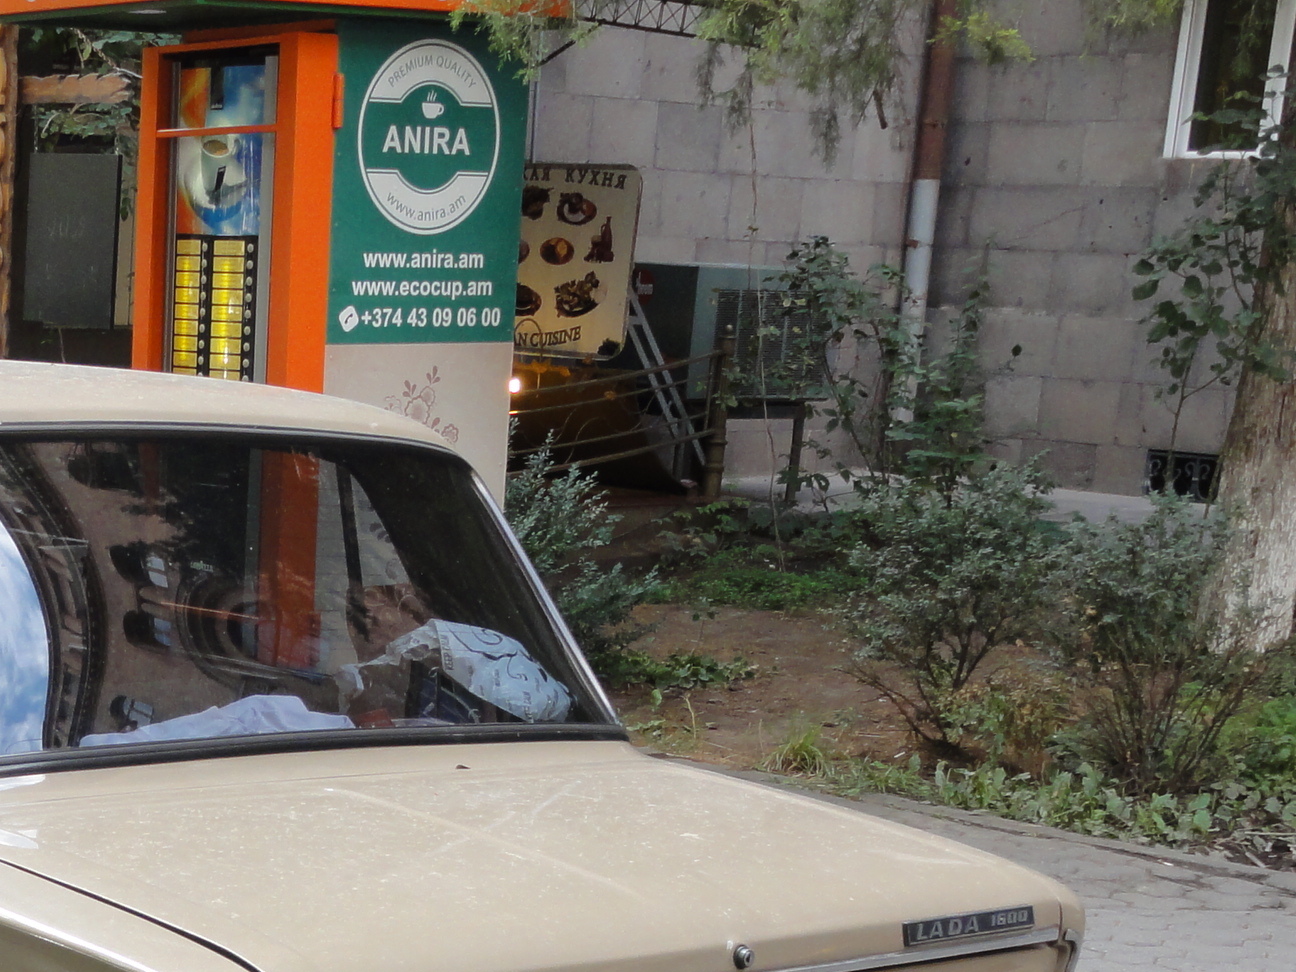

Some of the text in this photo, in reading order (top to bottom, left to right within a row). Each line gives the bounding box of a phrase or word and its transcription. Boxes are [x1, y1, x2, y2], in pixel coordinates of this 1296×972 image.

[387, 54, 477, 89] PREMIUM QUALITY
[382, 125, 471, 156] ANIRA
[564, 167, 628, 190] КУХНЯ
[386, 192, 467, 222] www.anira.am
[363, 248, 484, 269] www.anira.am
[351, 280, 493, 301] www.ecocup.am
[361, 307, 502, 328] +374 43 09 06 00
[530, 325, 582, 347] CUISINE
[916, 909, 1029, 941] LADA 1600
